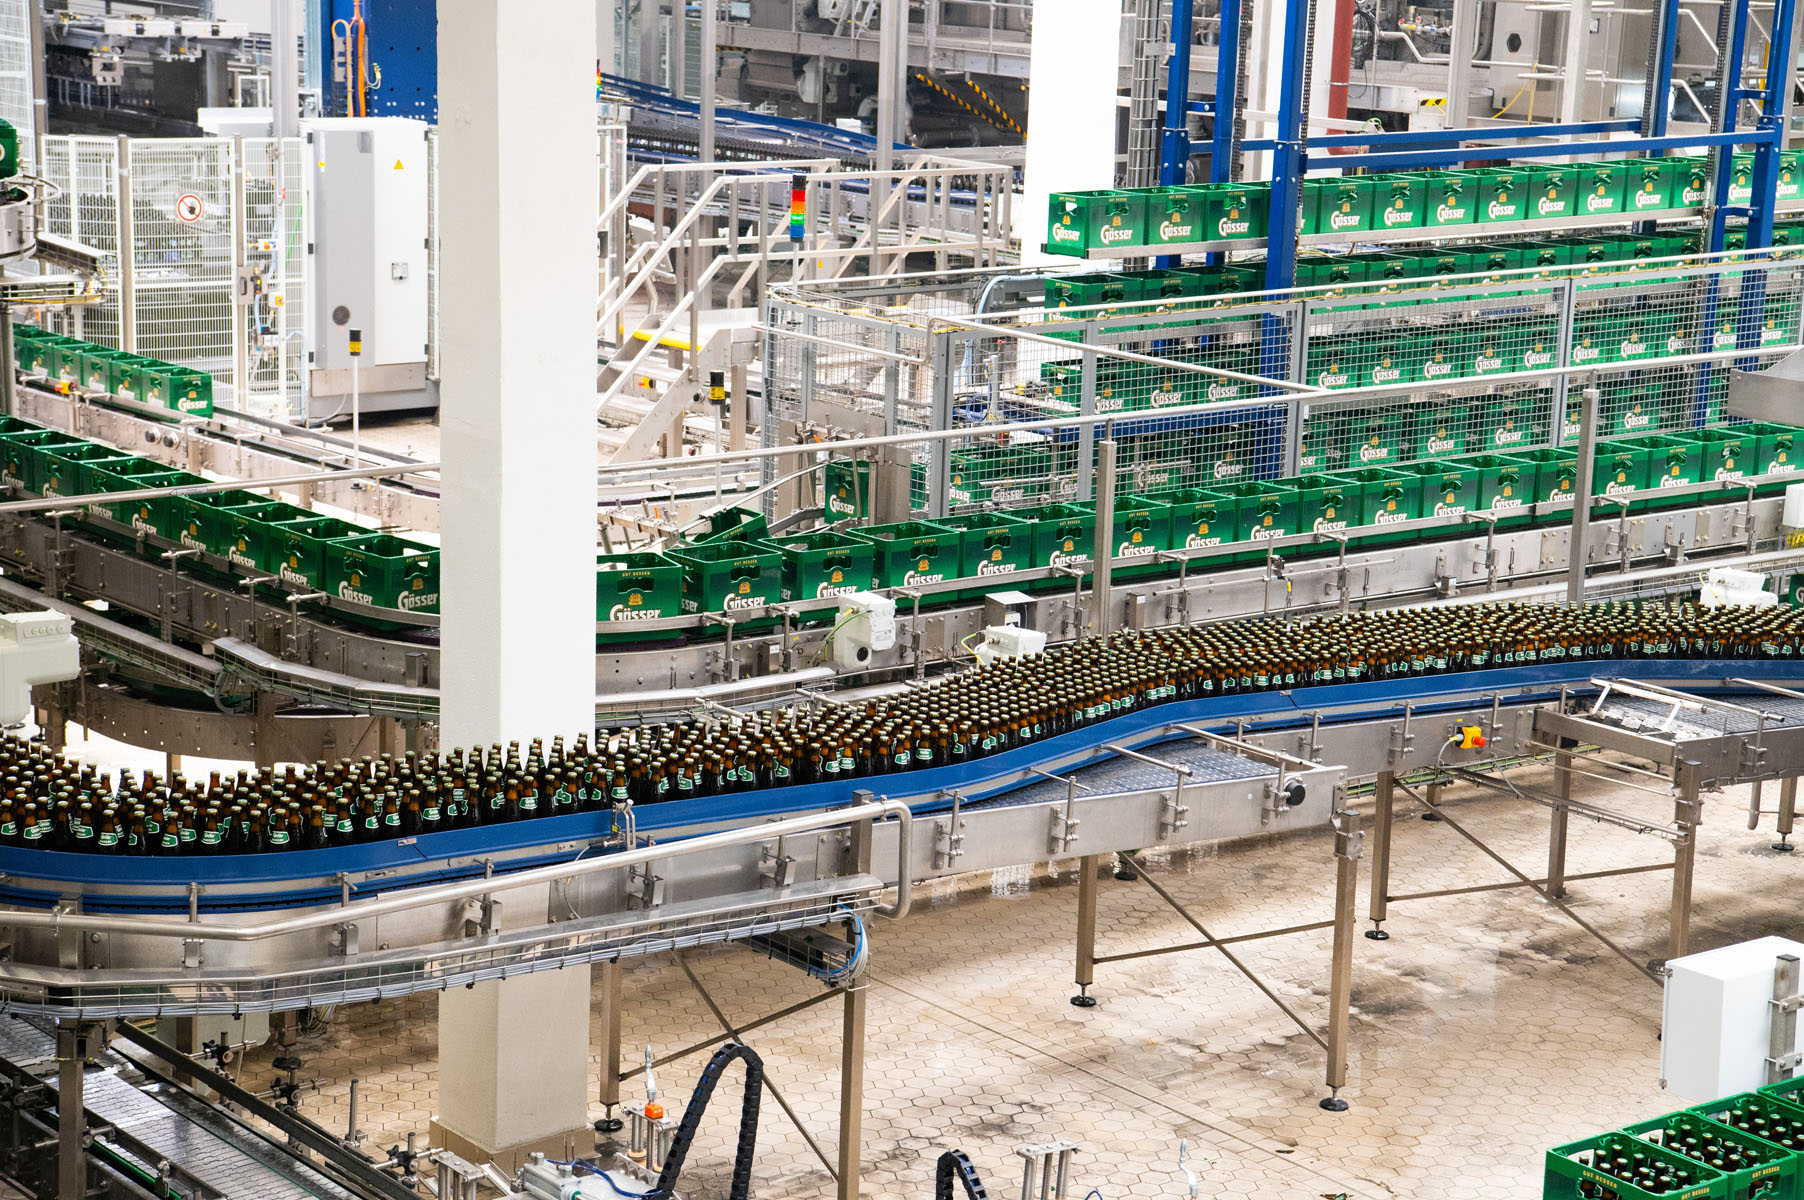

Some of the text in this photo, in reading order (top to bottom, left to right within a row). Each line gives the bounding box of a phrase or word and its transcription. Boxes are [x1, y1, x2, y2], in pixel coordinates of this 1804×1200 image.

[1538, 197, 1565, 215] Gösser
[1587, 194, 1614, 212] Gösser
[1635, 190, 1662, 208] Gösser
[1384, 207, 1413, 226] Gösser
[1436, 204, 1465, 223] Gösser
[1488, 201, 1517, 219] Gösser
[1219, 217, 1250, 237] Gösser
[1330, 210, 1361, 230] Gösser
[1053, 223, 1080, 241] Gösser
[1101, 225, 1133, 245] Gösser
[1160, 221, 1192, 241] Gösser
[1427, 436, 1456, 453] Gösser
[1495, 428, 1522, 445] Gösser
[1360, 444, 1388, 462] Gösser
[1715, 467, 1743, 481] Gösser
[1768, 461, 1796, 475] Gösser
[1606, 481, 1636, 496] Gösser
[1660, 475, 1689, 489] Gösser
[829, 494, 855, 514] Gösser
[1434, 502, 1466, 517] Gösser
[1492, 495, 1522, 510] Gösser
[1314, 517, 1347, 533] Gösser
[1375, 509, 1407, 525] Gösser
[1186, 533, 1221, 549] Gösser
[1251, 525, 1285, 541] Gösser
[1119, 541, 1155, 557] Gösser
[1050, 550, 1088, 566] Gösser
[978, 560, 1016, 576] Gösser
[904, 570, 944, 586] Gösser
[339, 580, 373, 605] Gösser
[817, 582, 857, 599] Gösser
[397, 590, 438, 610] Gösser
[682, 598, 698, 612] sser
[724, 593, 766, 610] Gösser
[610, 604, 661, 621] Gösser
